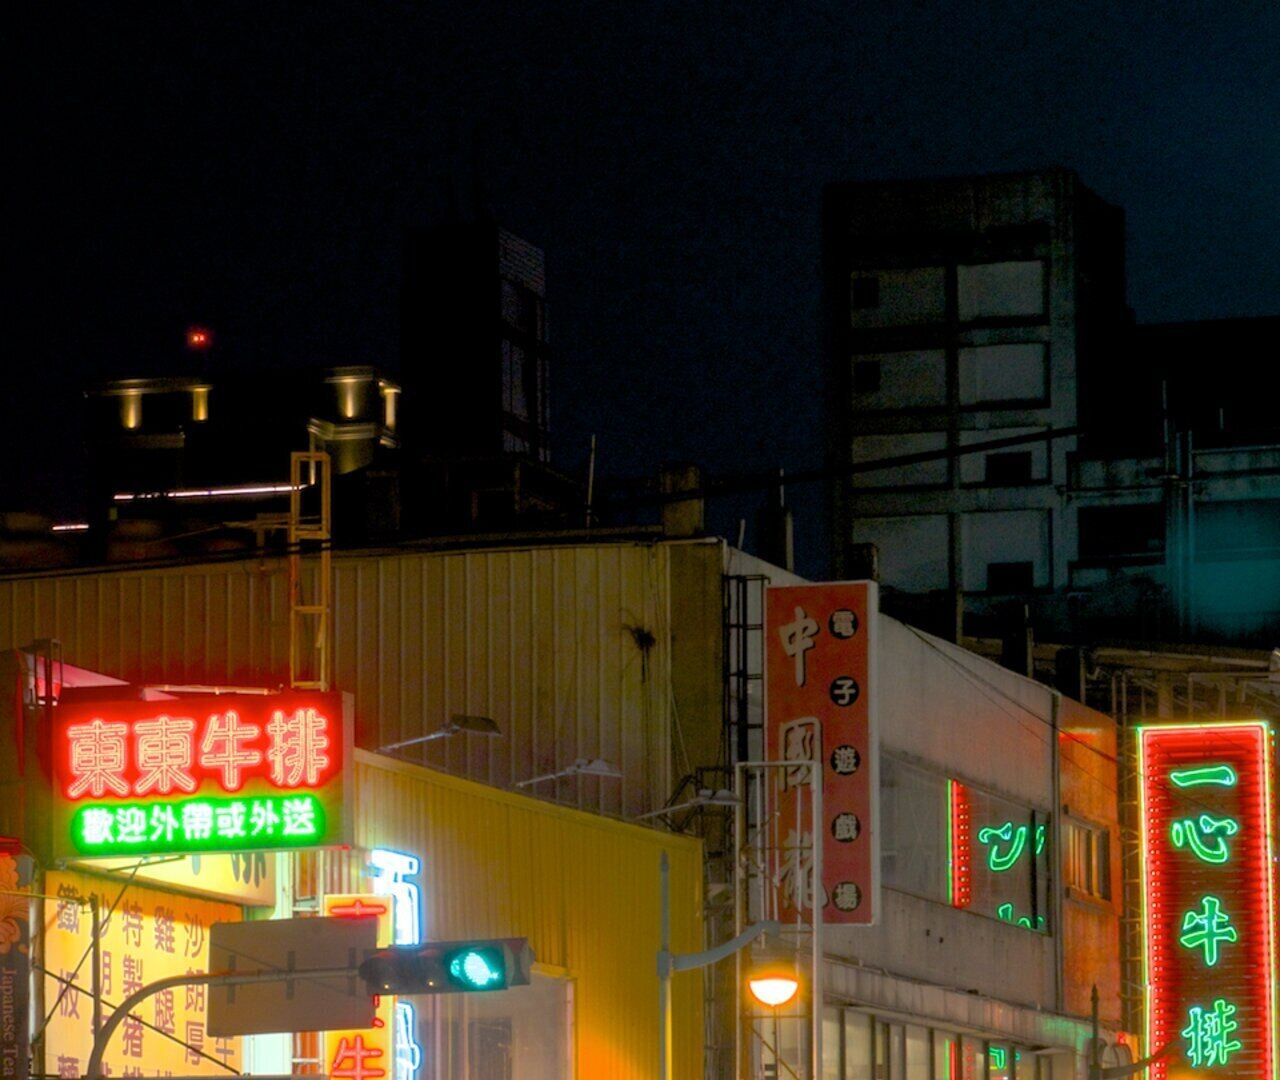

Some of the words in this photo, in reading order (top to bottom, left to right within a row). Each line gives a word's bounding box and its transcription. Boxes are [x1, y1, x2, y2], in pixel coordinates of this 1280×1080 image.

[67, 707, 330, 798] 東東牛排
[81, 796, 317, 846] 歡迎外帶或外送
[831, 609, 860, 909] 電子遊戲場
[1170, 764, 1242, 1068] 一心牛排
